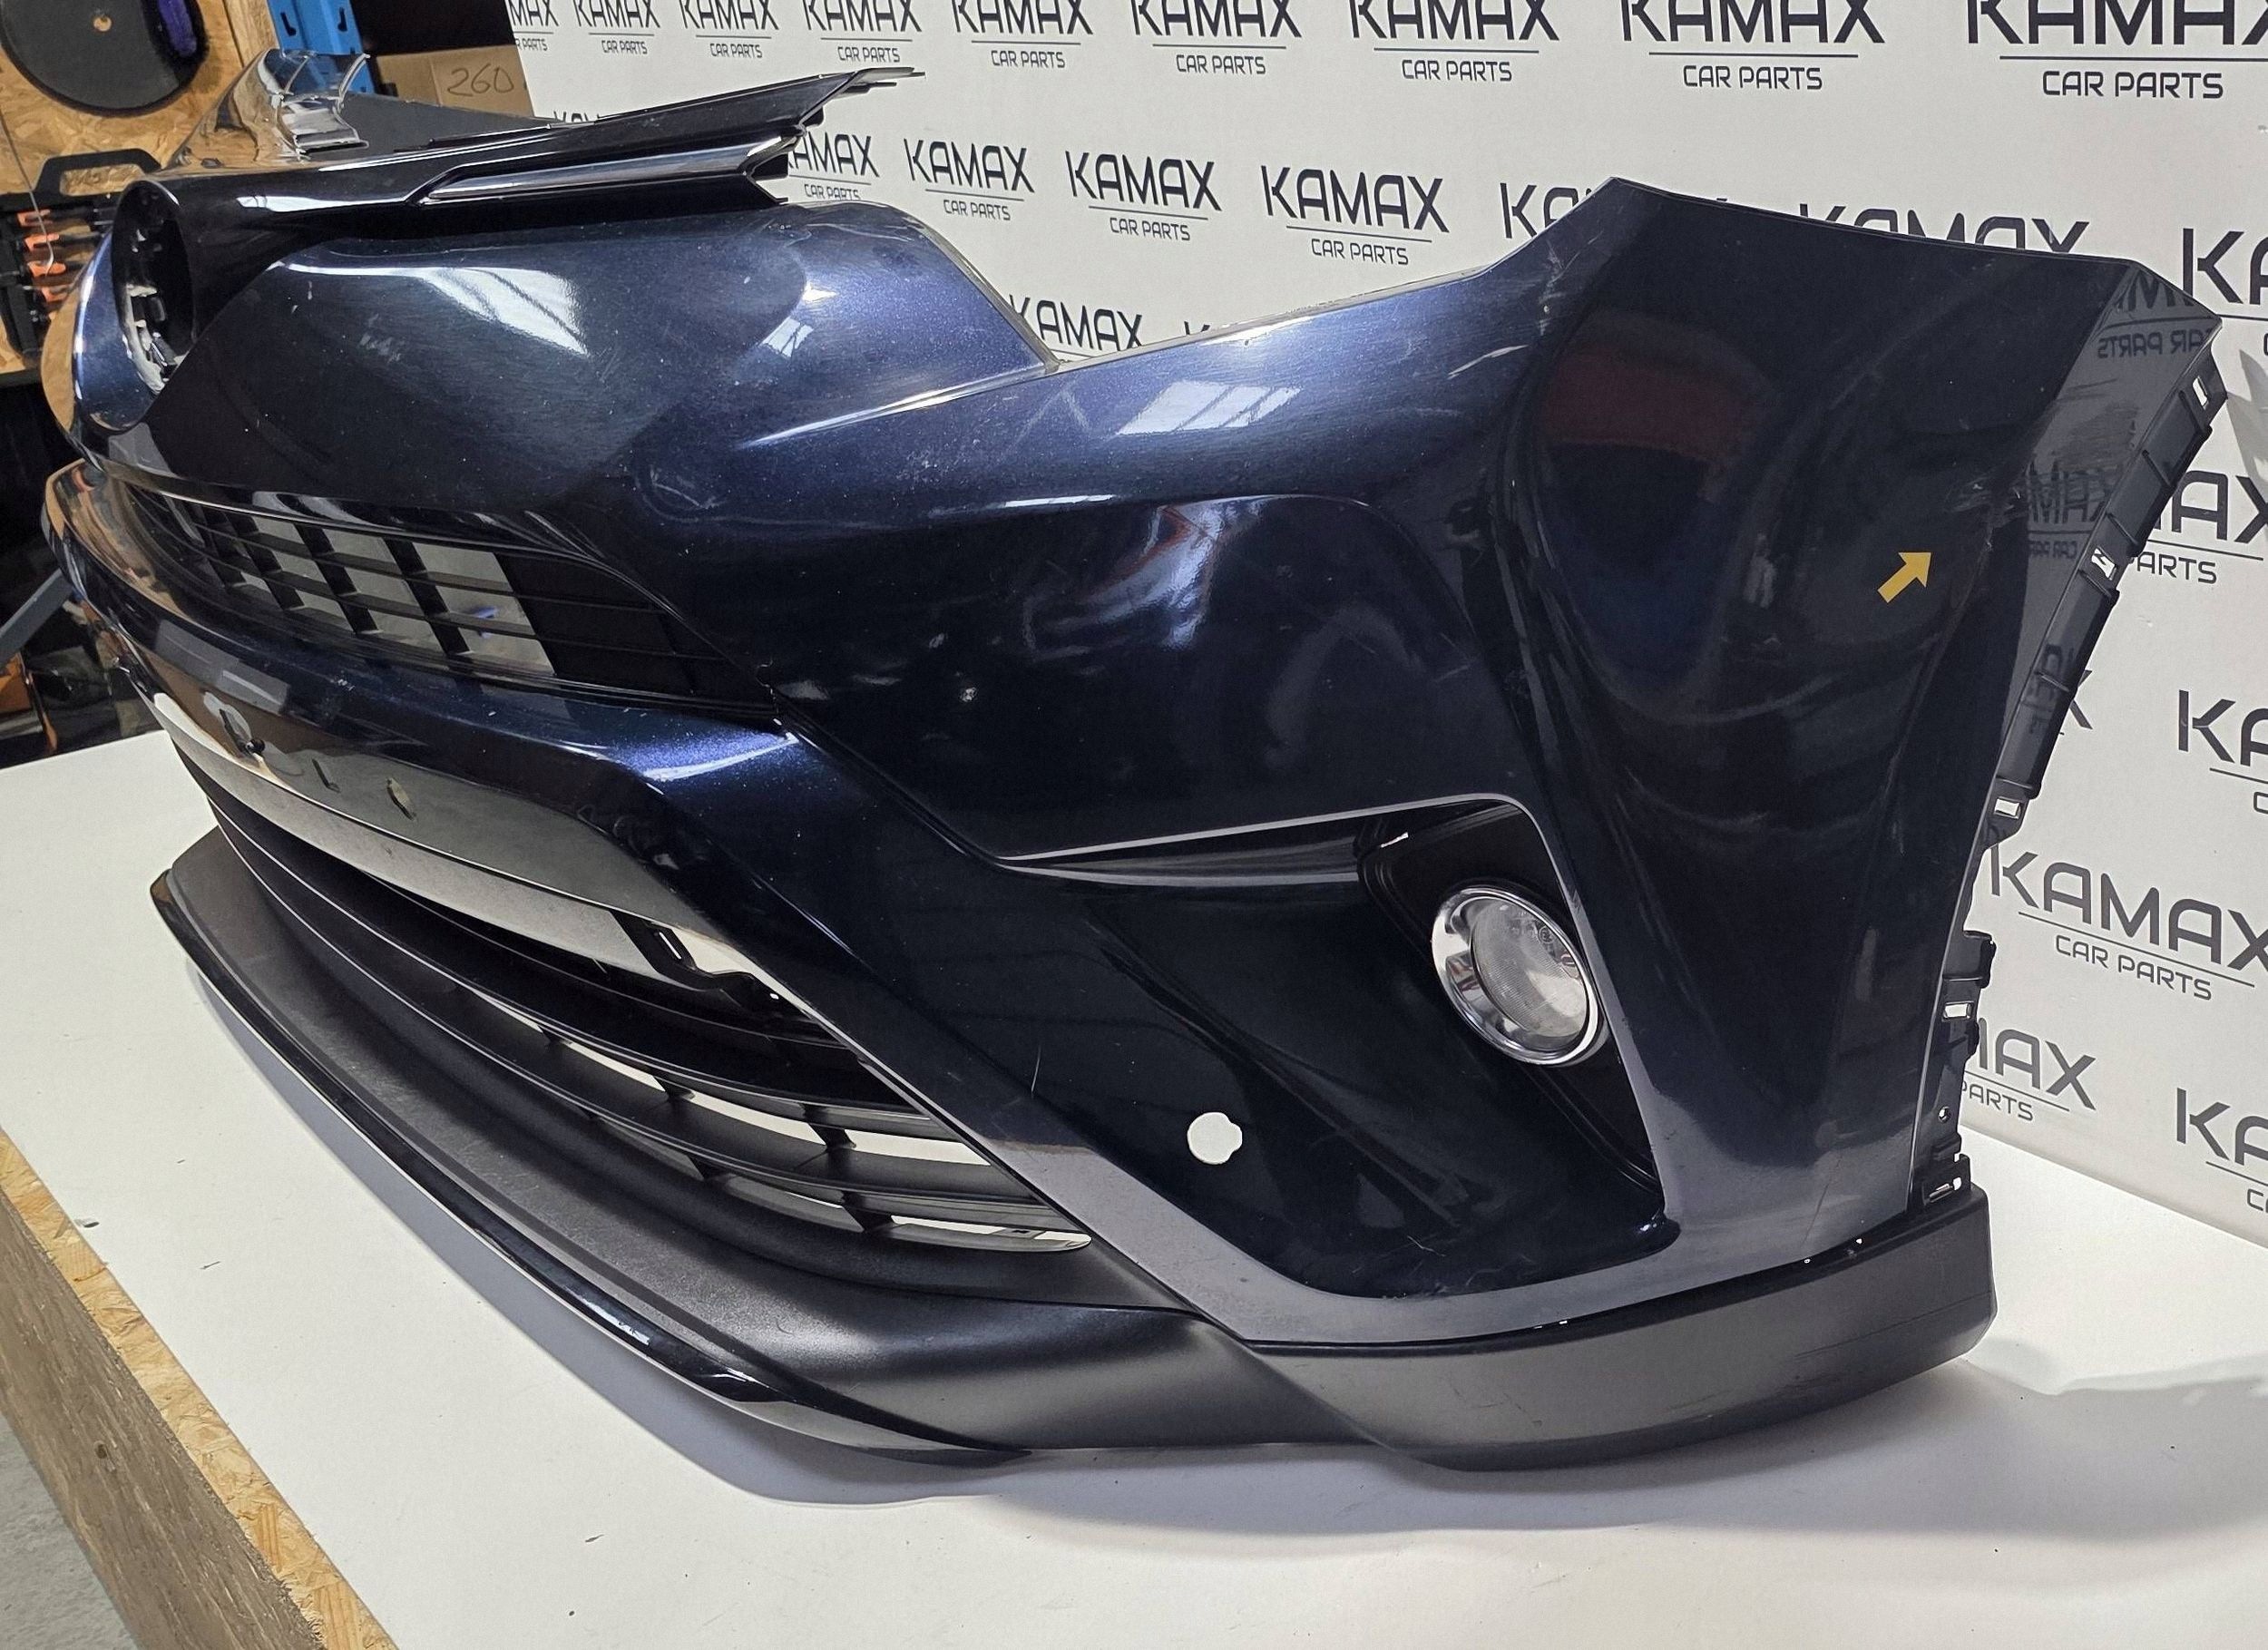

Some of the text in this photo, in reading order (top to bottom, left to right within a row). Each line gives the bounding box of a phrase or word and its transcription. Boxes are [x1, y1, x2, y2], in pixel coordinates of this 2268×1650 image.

[573, 0, 660, 28] KAMAX
[679, 0, 778, 30] KAMAX
[803, 0, 922, 32] KAMAX
[953, 0, 1093, 34] KAMAX
[1131, 0, 1302, 37] KAMAX
[1349, 0, 1559, 41] KAMAX
[1621, 0, 1885, 44] KAMAX
[601, 41, 647, 54] CAR PARTS
[710, 44, 762, 58] CAR PARTS
[838, 46, 900, 63] CAR PARTS
[992, 51, 1065, 68] CAR PARTS
[1177, 54, 1266, 74] CAR PARTS
[1403, 60, 1511, 82] CAR PARTS
[1684, 65, 1822, 90] CAR PARTS
[447, 63, 513, 97] 260
[2043, 71, 2223, 99] CAR PARTS
[787, 132, 880, 178] AMAX
[904, 139, 1034, 193] KAMAX
[805, 184, 825, 198] CAR
[1065, 151, 1221, 212] KAMAX
[943, 200, 1010, 220] CAR PARTS
[1261, 165, 1449, 234] KAMAX
[1110, 218, 1190, 240] CAR PARTS
[1312, 239, 1410, 265] CAR PARTS
[2057, 933, 2213, 1002] CAR PARTS
